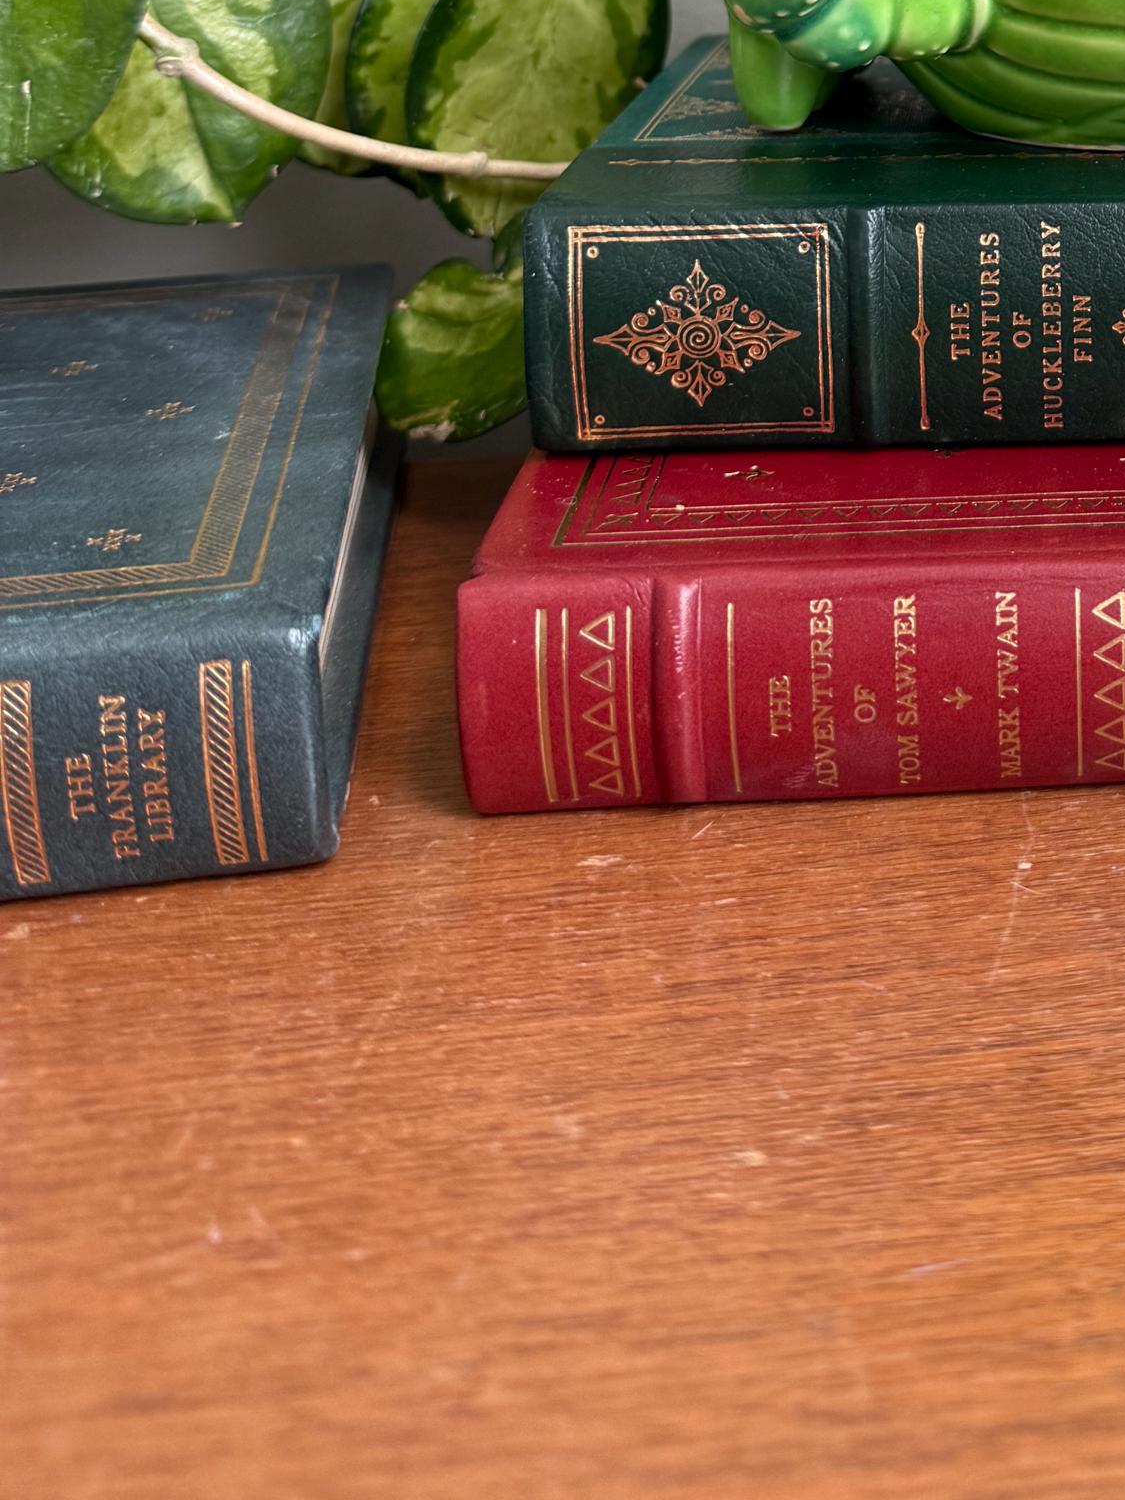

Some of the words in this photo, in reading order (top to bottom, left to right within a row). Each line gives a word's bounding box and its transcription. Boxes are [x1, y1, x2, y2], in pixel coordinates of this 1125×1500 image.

[950, 301, 971, 361] THE
[979, 231, 1003, 421] ADVENTURES
[1012, 310, 1032, 349] OF
[1040, 220, 1065, 430] HUCKLEBERRY
[1072, 294, 1094, 363] FINN
[893, 594, 919, 726] SAWYER
[995, 591, 1020, 699] TWAIN
[769, 675, 792, 738] THE
[809, 597, 839, 788] ADVENTURES
[853, 684, 876, 724] OF
[97, 694, 142, 860] FRANKLIN
[135, 707, 175, 843] LIBRARY
[896, 733, 921, 785] TOM
[998, 706, 1022, 778] MARK
[64, 753, 97, 821] THE
